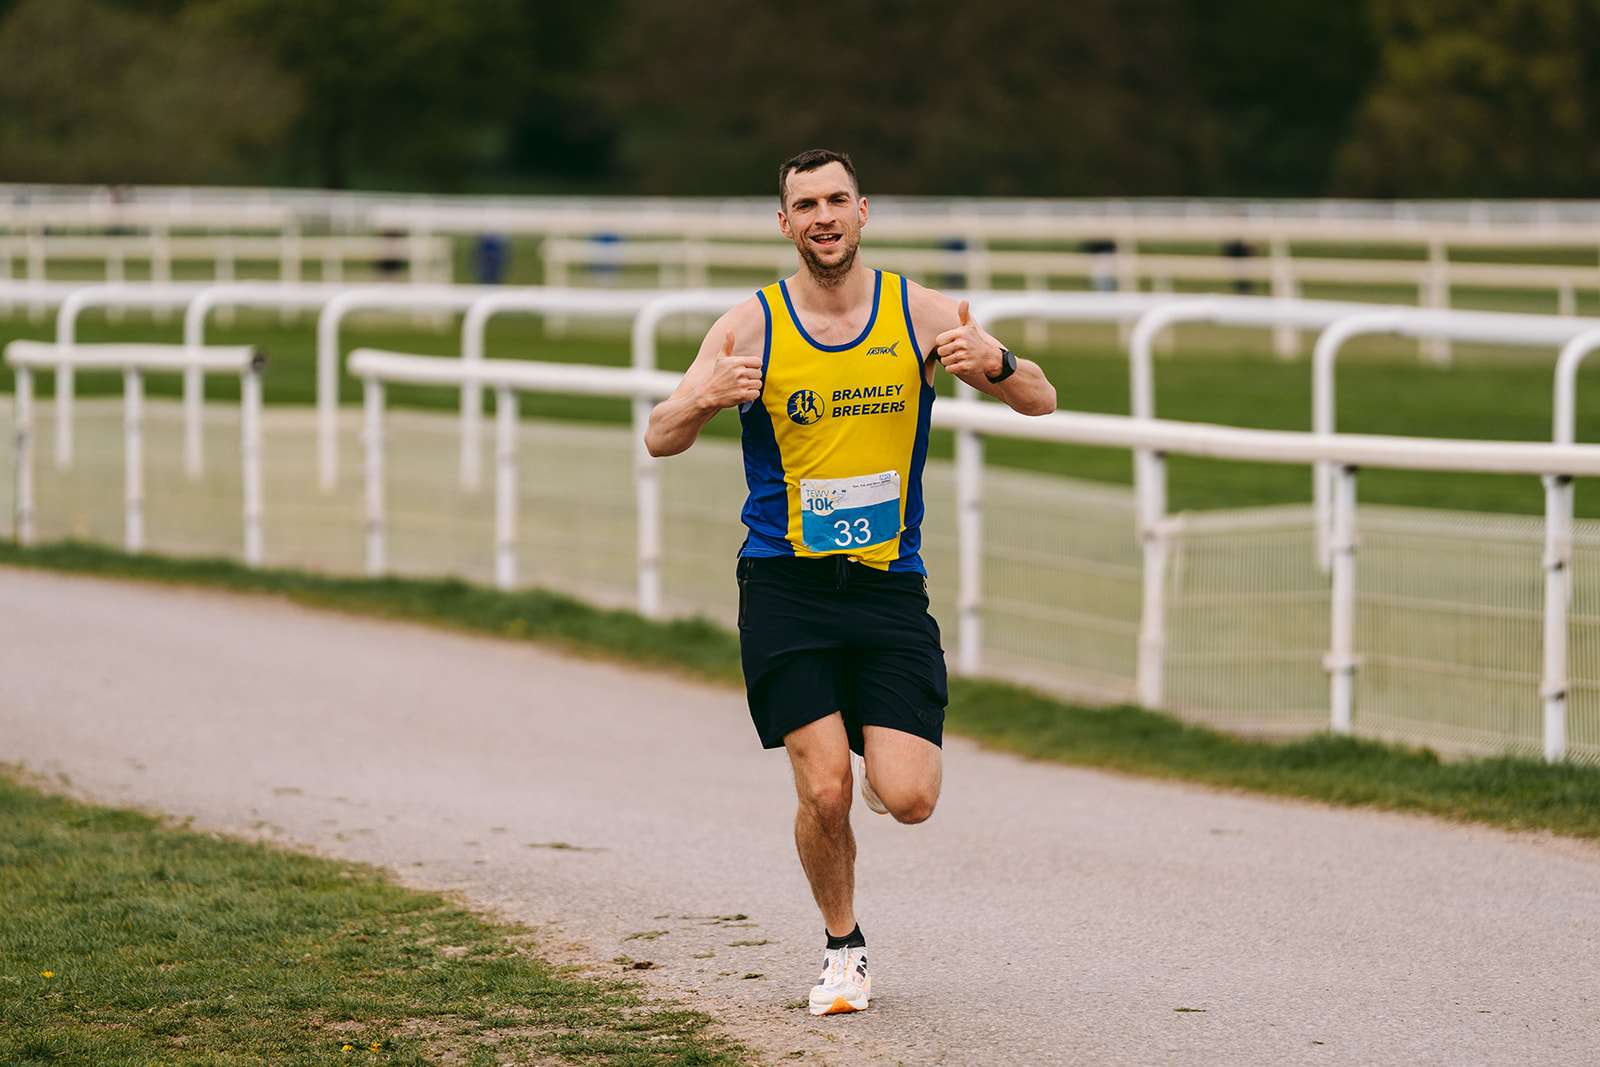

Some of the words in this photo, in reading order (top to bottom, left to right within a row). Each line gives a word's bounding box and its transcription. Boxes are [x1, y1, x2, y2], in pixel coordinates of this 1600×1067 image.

[832, 384, 904, 401] BRAMLEY
[832, 400, 905, 417] BREEZERS
[806, 489, 829, 497] TEWV
[806, 497, 834, 511] 10k
[833, 518, 872, 546] 33
